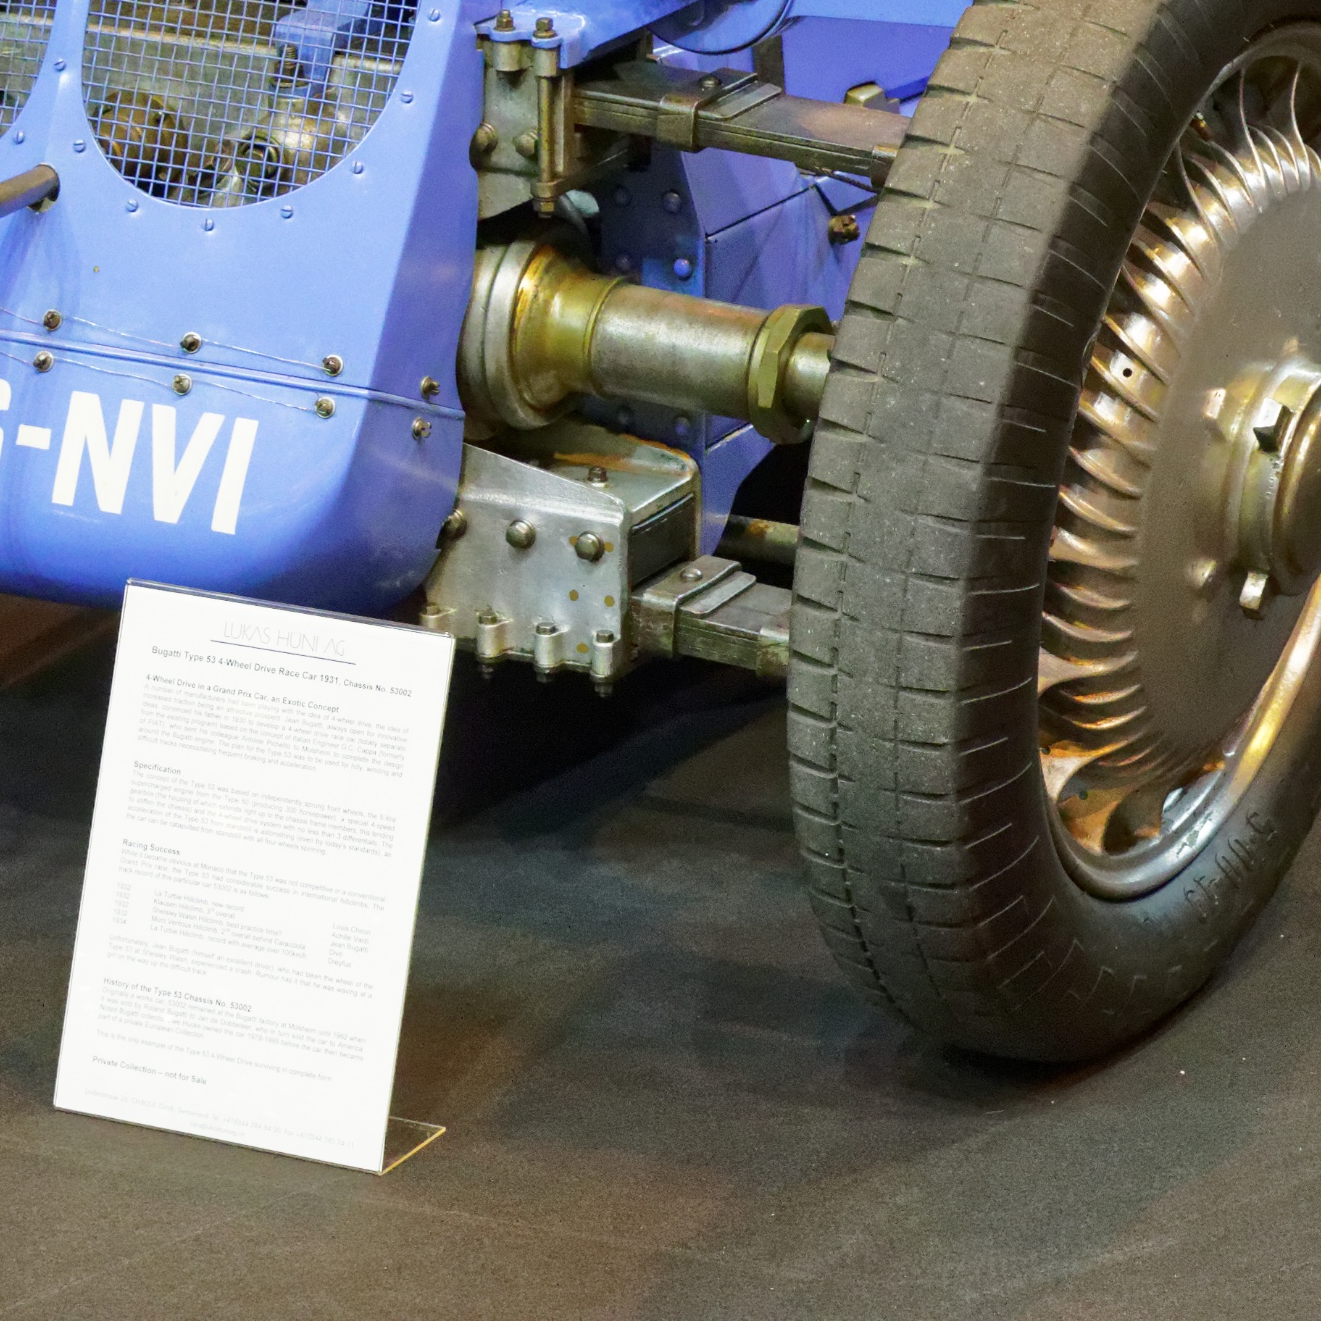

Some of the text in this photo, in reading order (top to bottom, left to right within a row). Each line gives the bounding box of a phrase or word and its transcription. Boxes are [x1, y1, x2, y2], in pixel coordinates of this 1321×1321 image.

[223, 620, 271, 644] LUKAS
[151, 645, 181, 660] Bugatti
[183, 651, 203, 663] Type
[218, 656, 252, 670] 4-Wheel
[254, 663, 276, 674] Drive
[278, 667, 299, 678] Race
[302, 671, 316, 681] Car
[343, 678, 373, 690] Chassis
[389, 686, 412, 697] 53002
[146, 672, 175, 685] 4-Wheel
[176, 678, 196, 689] Drive
[212, 684, 236, 696] Grand
[237, 688, 252, 698] Prix
[282, 696, 305, 708] Exotic
[307, 700, 339, 715] Concept
[133, 760, 181, 777] Specification
[122, 837, 180, 856] Racing Success
[102, 976, 129, 990] History
[140, 983, 152, 993] the
[153, 986, 171, 998] Type
[183, 991, 213, 1005] Chassis
[229, 1000, 251, 1012] 53002
[92, 1054, 206, 1085] Private Collection not for Sale
